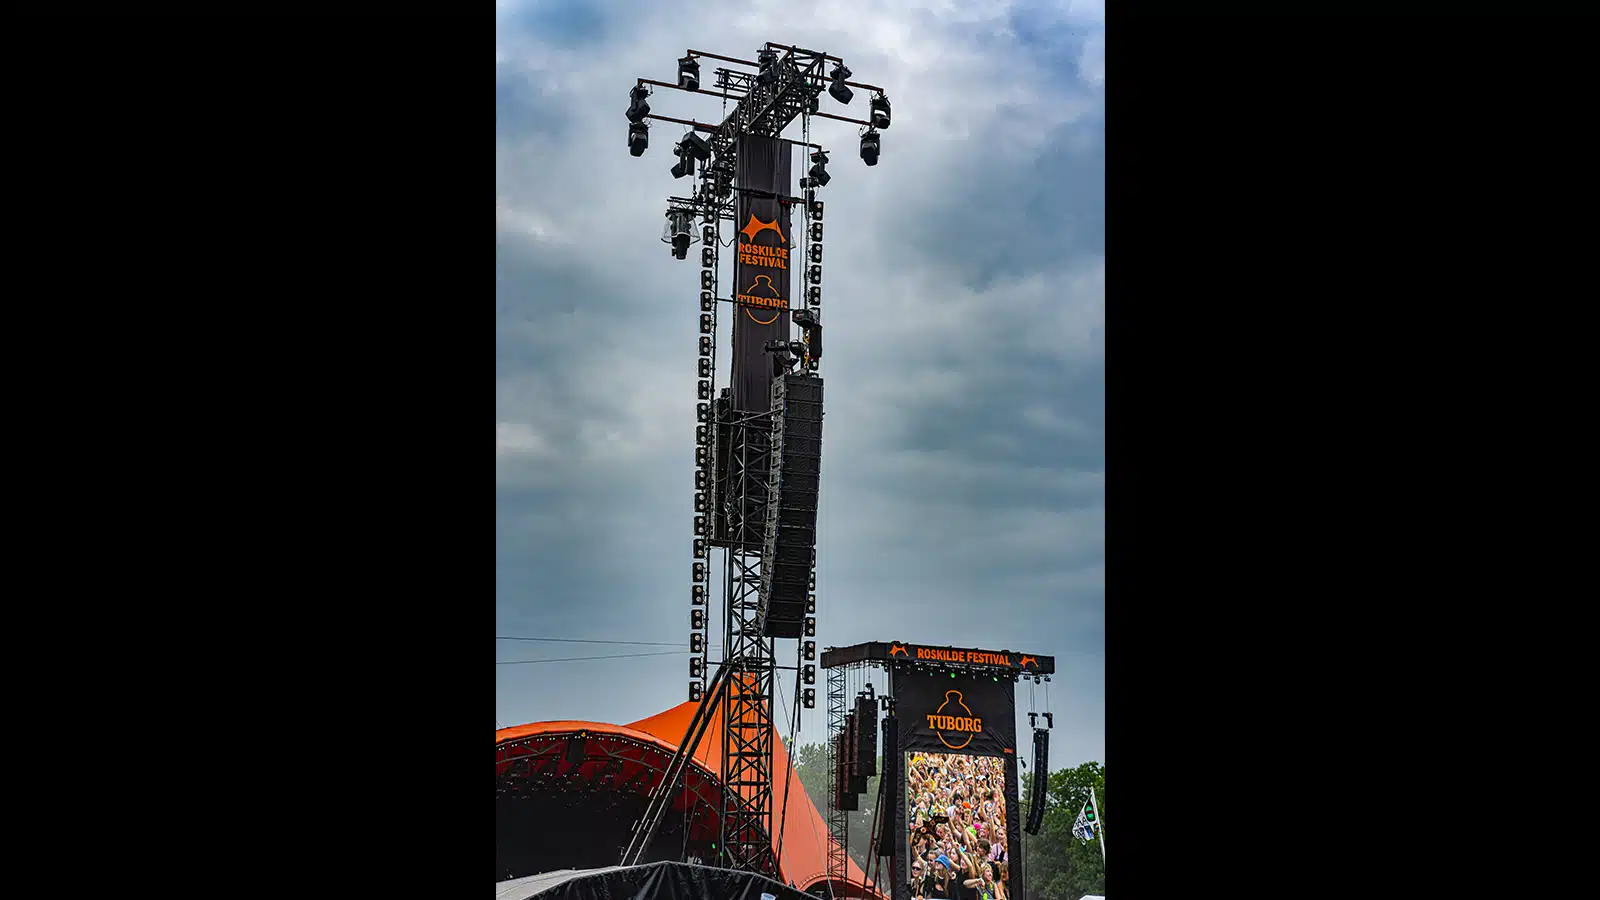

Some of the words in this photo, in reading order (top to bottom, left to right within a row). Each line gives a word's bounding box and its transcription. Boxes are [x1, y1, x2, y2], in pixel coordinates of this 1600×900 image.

[739, 242, 788, 259] ROSKILDE
[740, 254, 786, 269] FESTIVAL
[917, 648, 965, 662] ROSKILDE
[967, 651, 1011, 666] FESTIVAL
[927, 714, 982, 733] TUBORG
